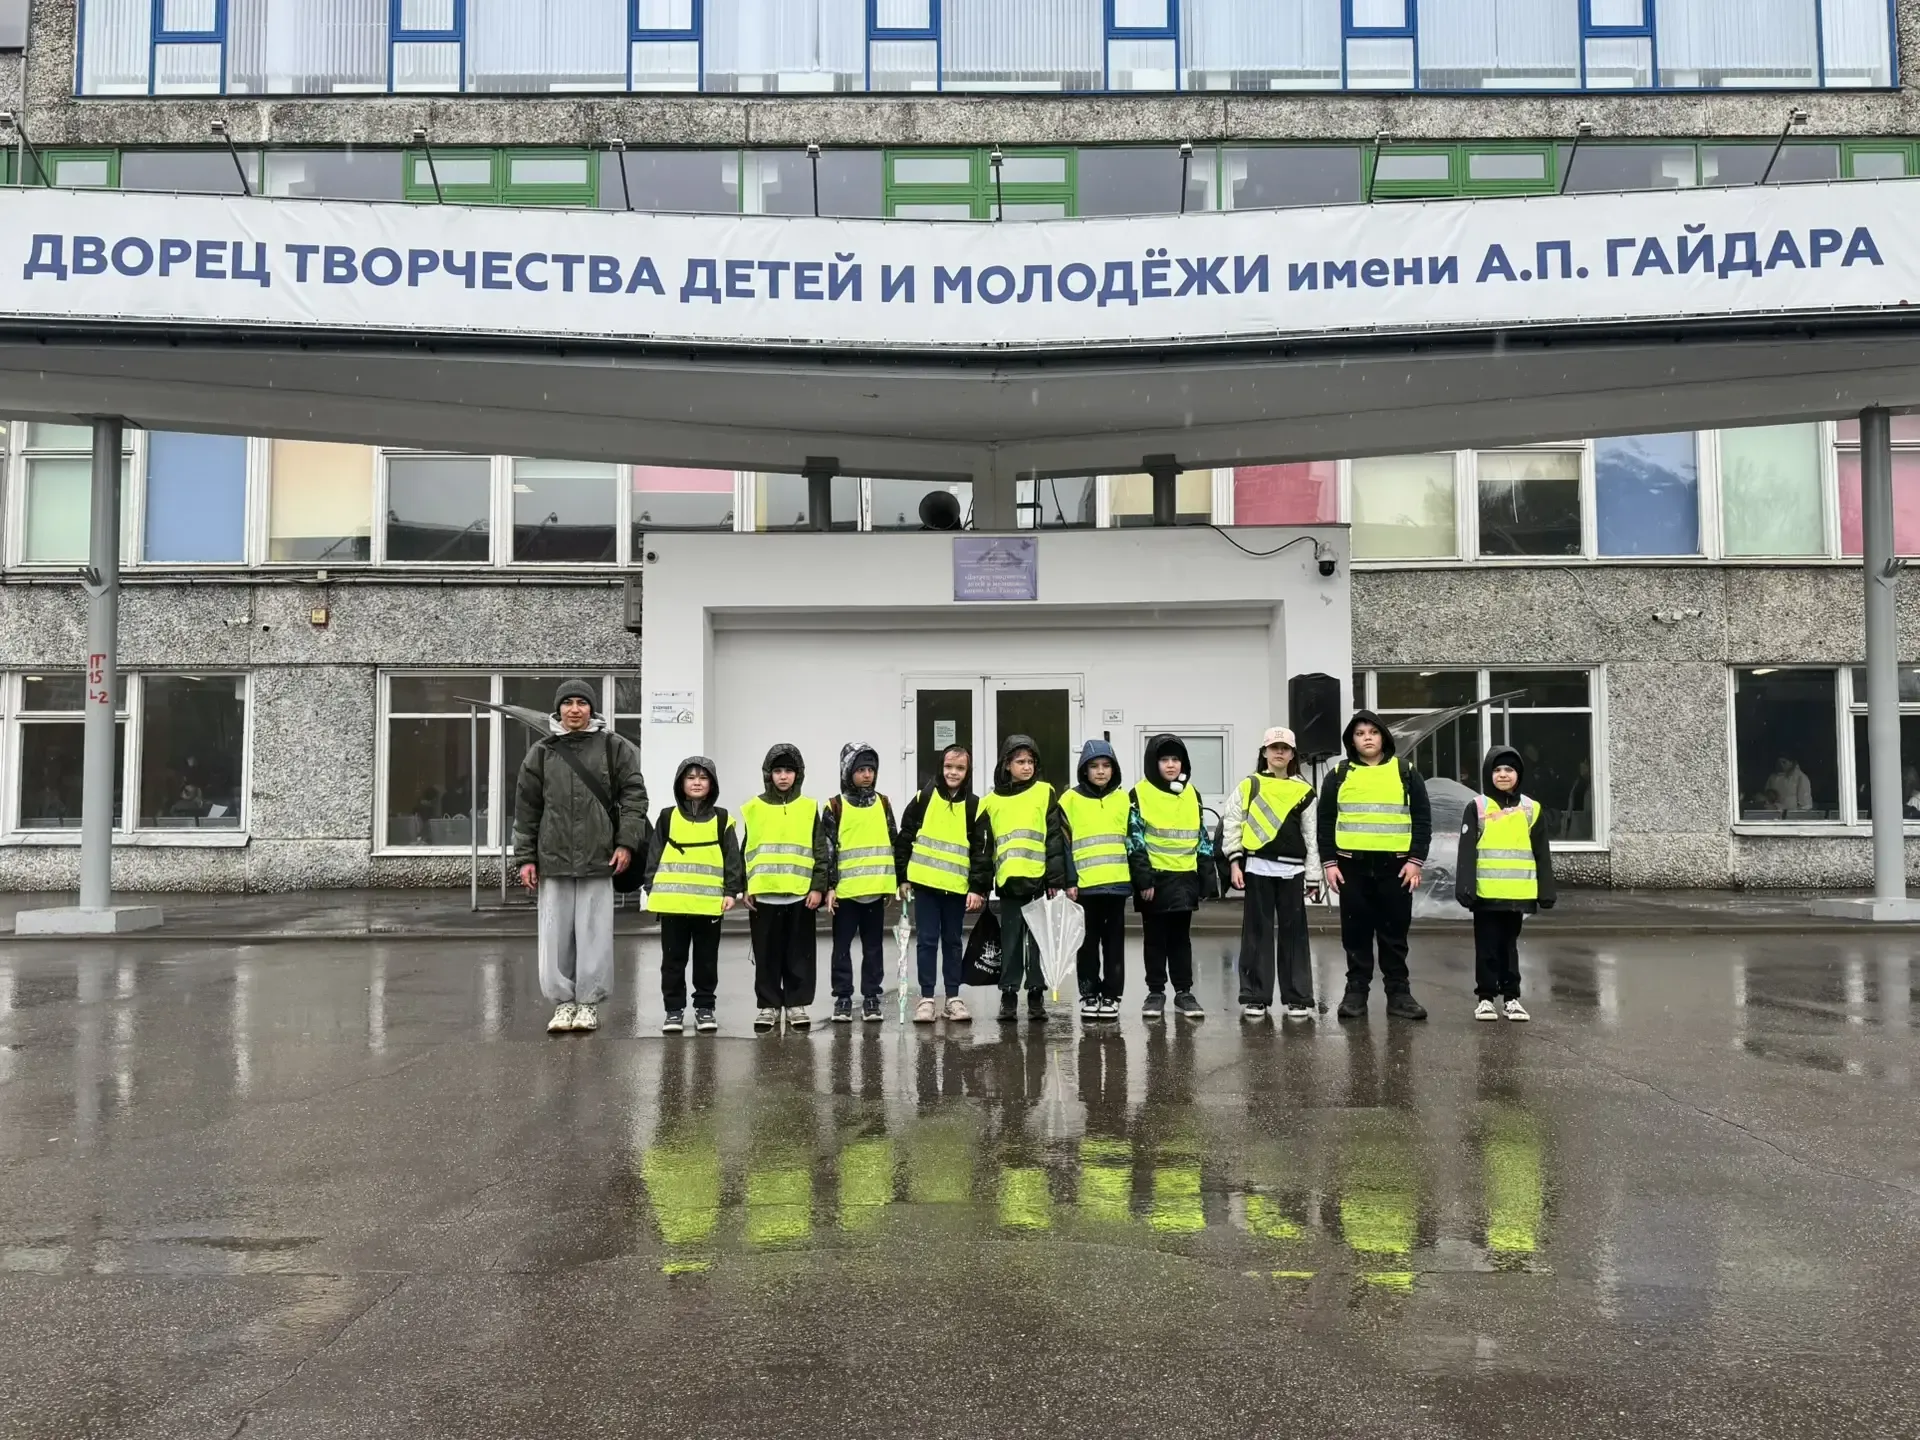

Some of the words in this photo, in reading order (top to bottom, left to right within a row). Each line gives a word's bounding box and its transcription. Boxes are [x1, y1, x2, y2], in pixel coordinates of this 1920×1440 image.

[23, 232, 271, 288] ДВОРЕЦ
[286, 243, 666, 295] ТВОРЧЕСТВА
[680, 252, 863, 304] ДЕТЕЙ
[880, 264, 915, 304] И
[933, 248, 1271, 308] МОЛОДЁЖИ
[1287, 254, 1459, 293] имени
[1476, 240, 1590, 282] А.П.
[1606, 223, 1885, 280] ГАЙДАРА
[88, 670, 104, 684] 15
